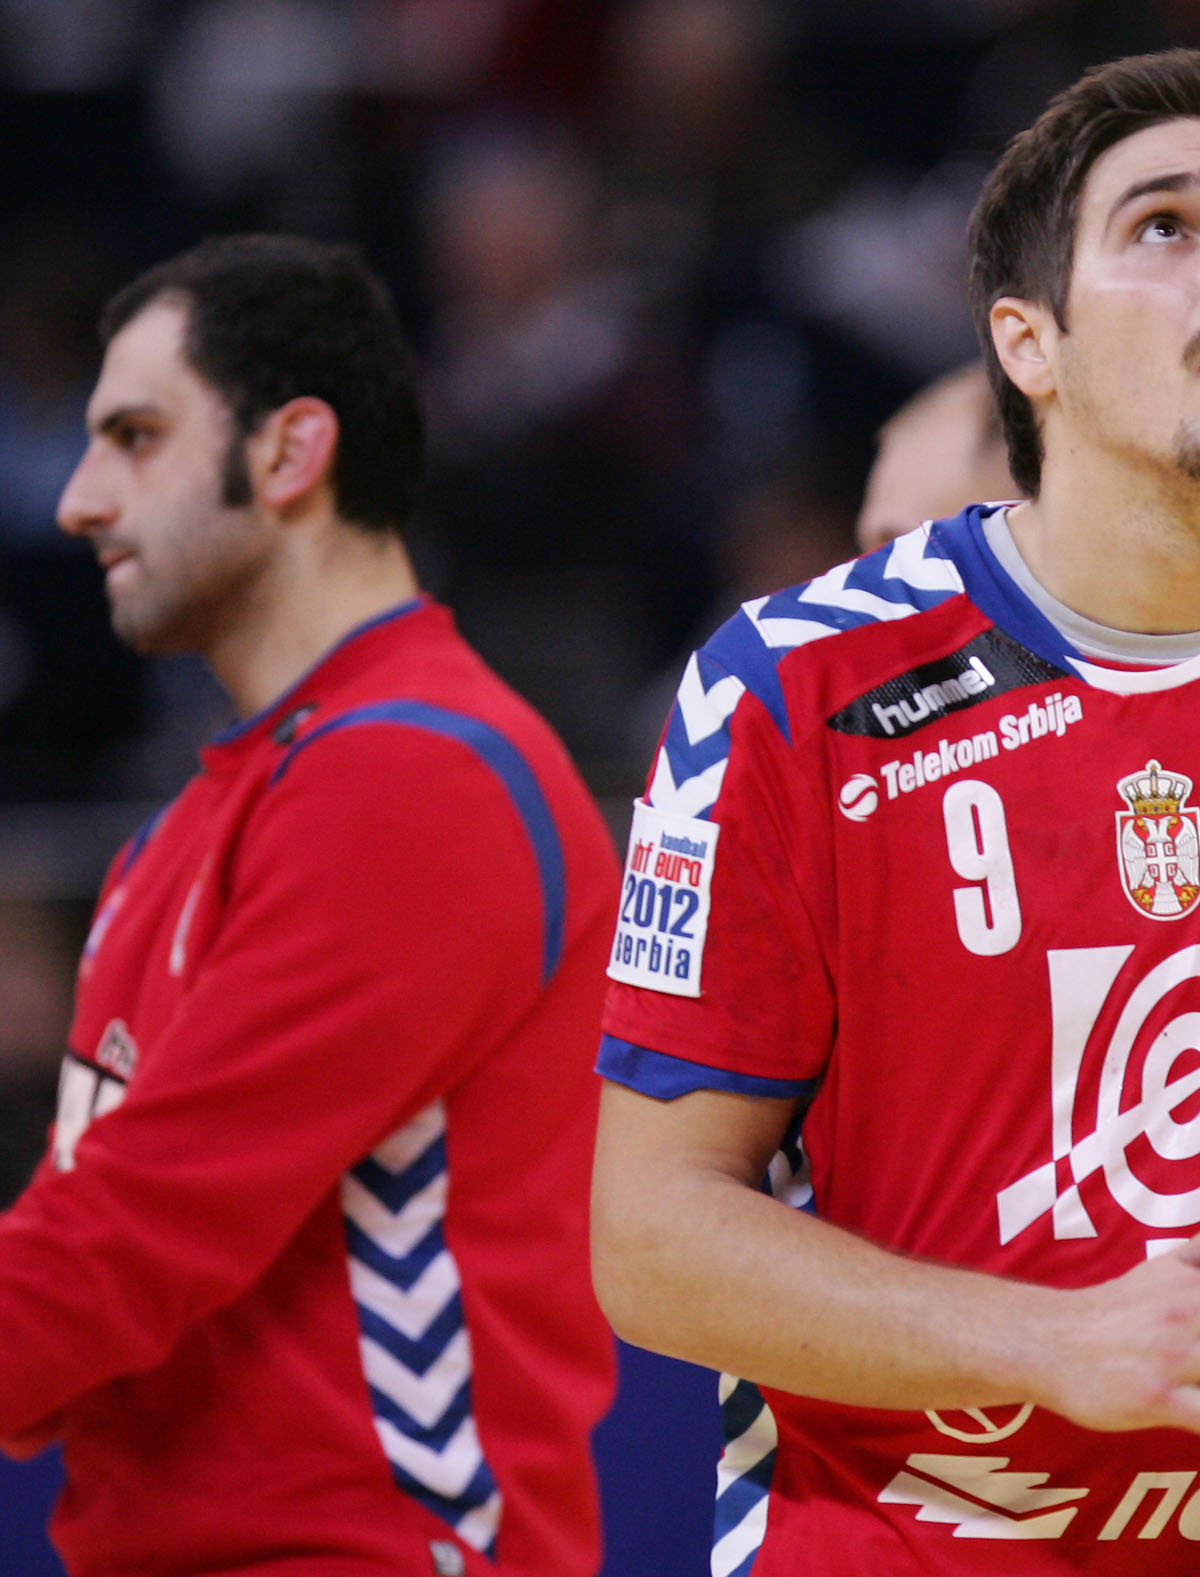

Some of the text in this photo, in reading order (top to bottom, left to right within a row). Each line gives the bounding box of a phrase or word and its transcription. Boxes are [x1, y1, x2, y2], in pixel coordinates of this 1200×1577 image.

[872, 656, 995, 735] hummel
[881, 692, 1083, 800] Telekom Srbija
[621, 873, 700, 939] 2012
[655, 851, 702, 887] euro
[943, 779, 1022, 956] 9
